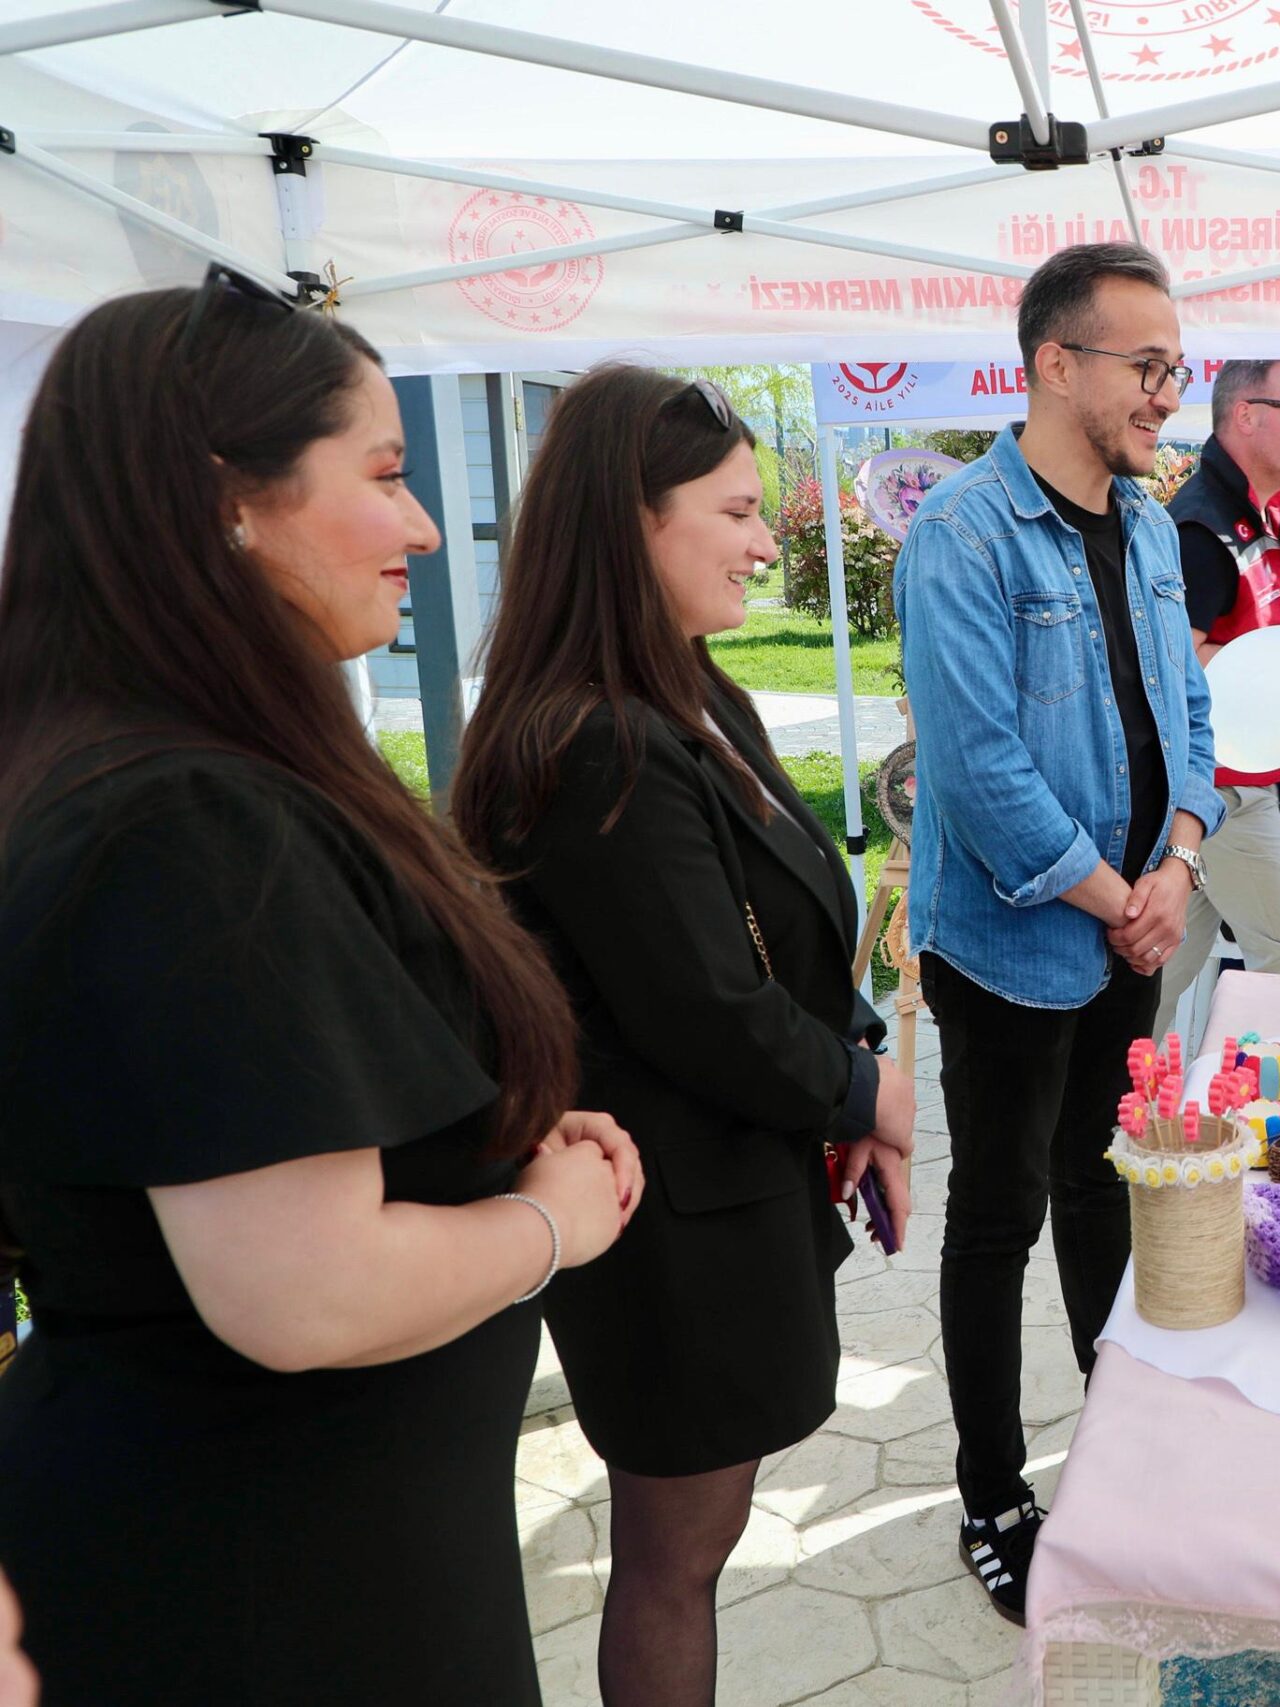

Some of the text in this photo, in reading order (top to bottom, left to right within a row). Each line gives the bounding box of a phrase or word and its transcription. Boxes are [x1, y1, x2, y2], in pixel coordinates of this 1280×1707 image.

[831, 373, 920, 412] 2025 AİLE YILI
[970, 362, 1028, 396] AİLE
